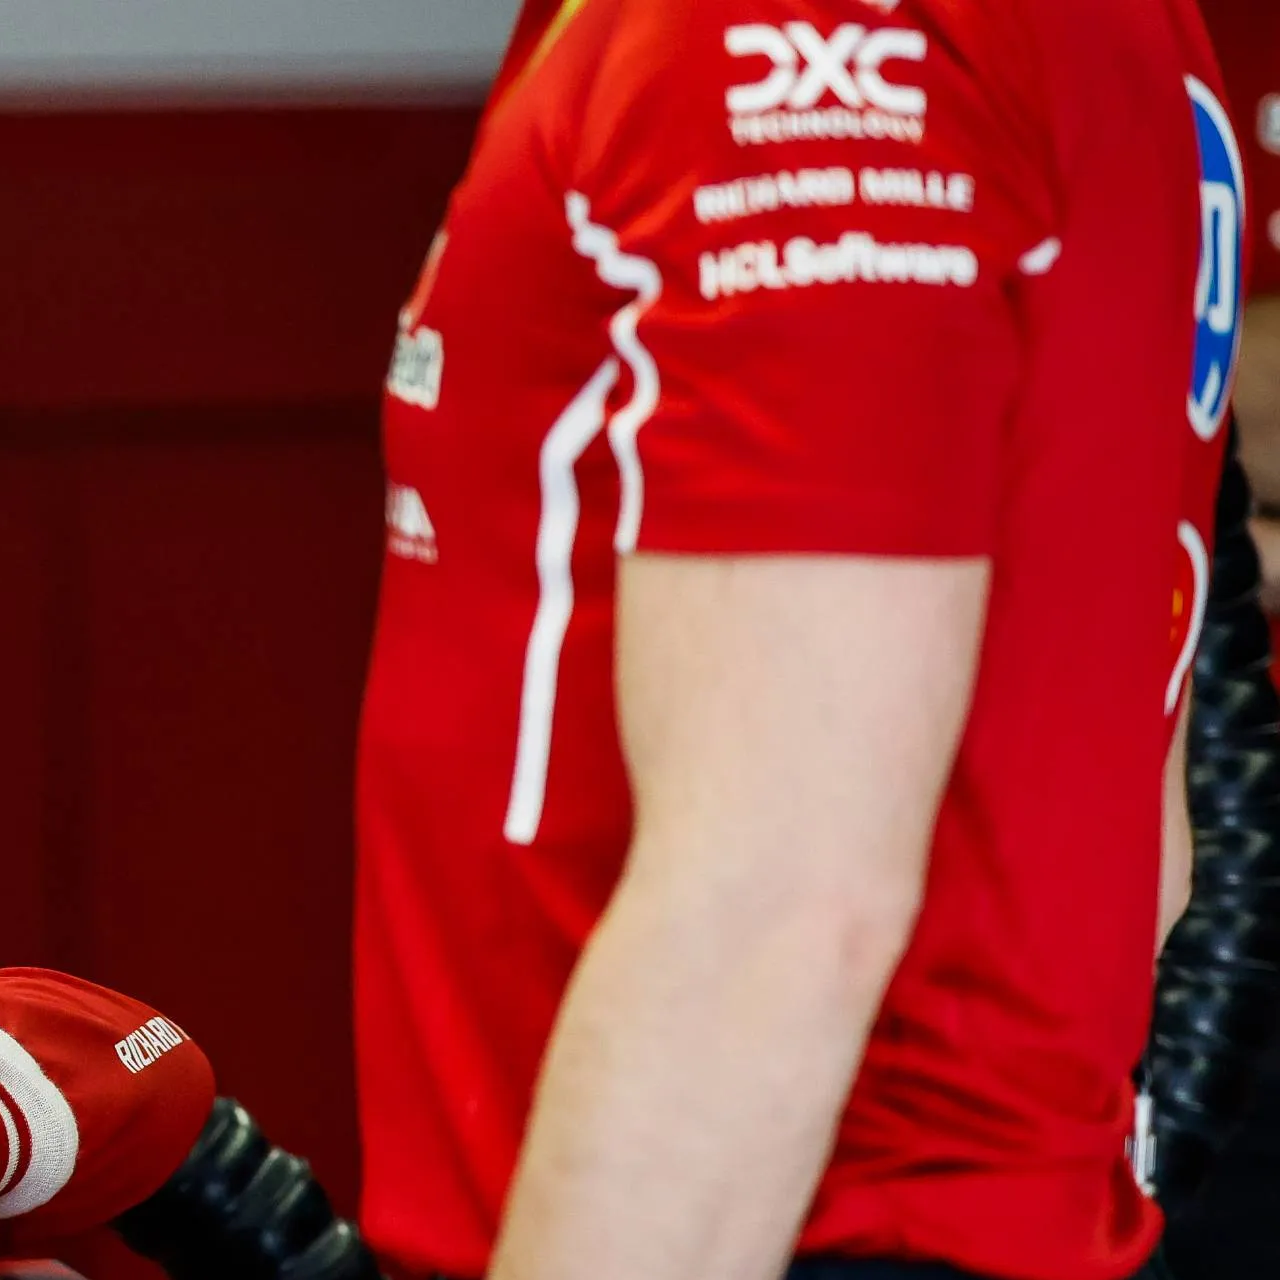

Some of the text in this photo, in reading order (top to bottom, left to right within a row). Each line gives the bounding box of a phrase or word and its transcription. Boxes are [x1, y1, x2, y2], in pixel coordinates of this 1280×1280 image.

[724, 20, 928, 116] DXC
[859, 166, 975, 213] MILLE
[114, 1016, 184, 1074] RICHARD
